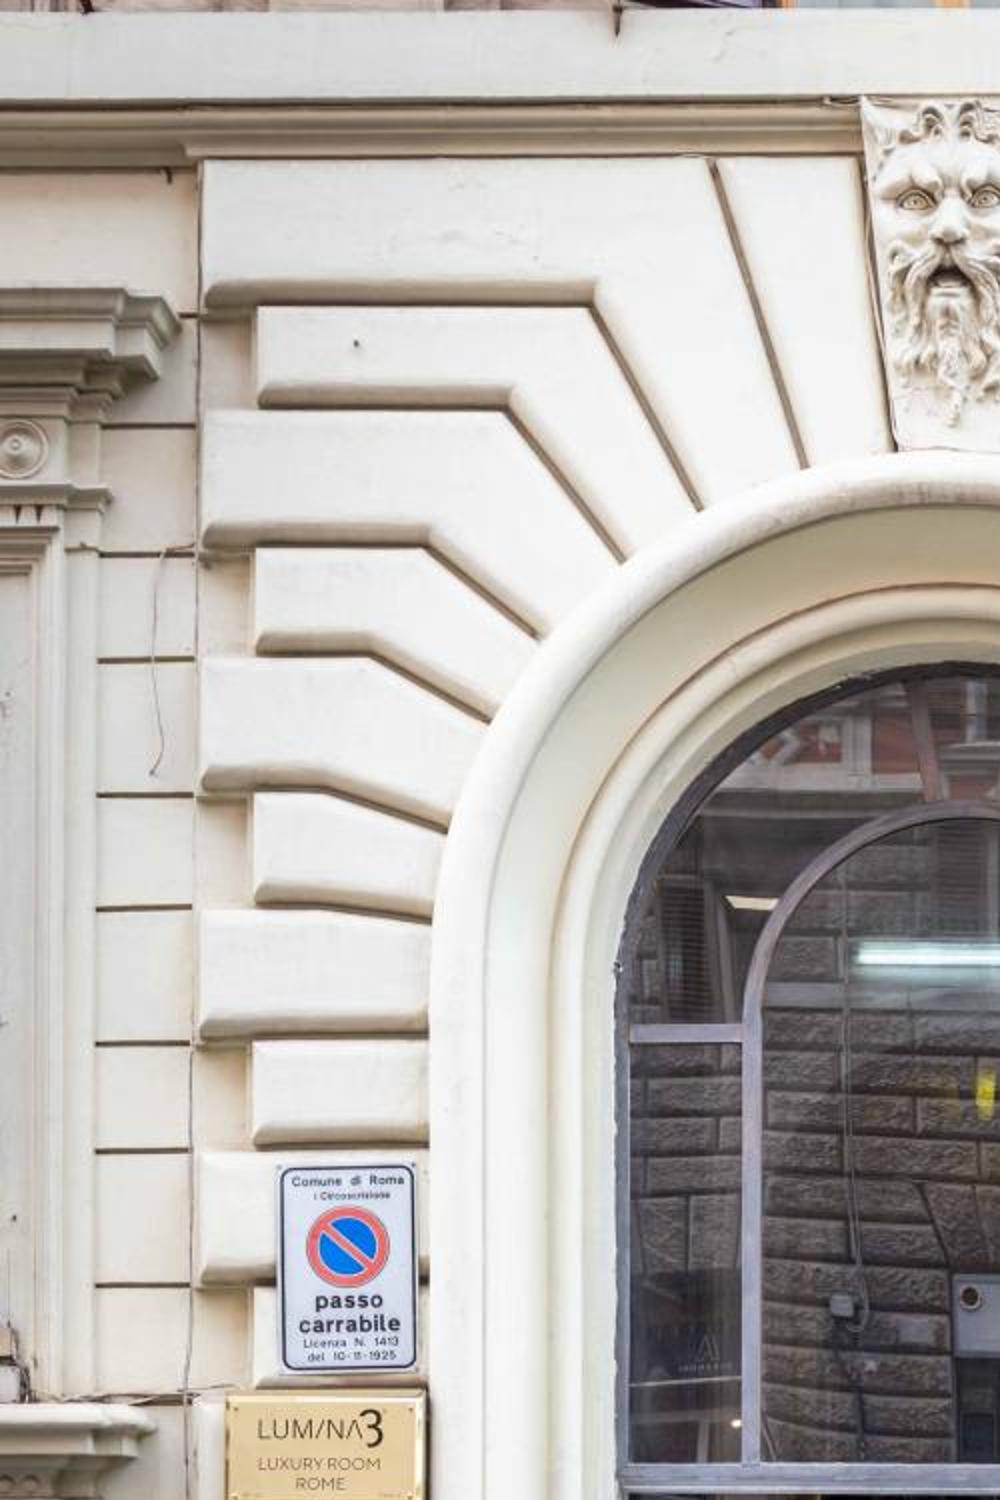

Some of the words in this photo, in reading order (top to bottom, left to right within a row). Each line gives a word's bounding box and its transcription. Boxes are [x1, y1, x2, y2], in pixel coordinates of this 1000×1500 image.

[291, 1175, 342, 1187] Comune
[350, 1175, 362, 1186] di
[369, 1174, 405, 1185] Roma
[315, 1294, 383, 1312] passo
[299, 1314, 400, 1334] carrabile
[303, 1337, 347, 1349] Licenza
[307, 1351, 325, 1362] del
[258, 1457, 322, 1472] LUXURY
[328, 1457, 381, 1472] ROOM
[295, 1477, 347, 1491] ROME
